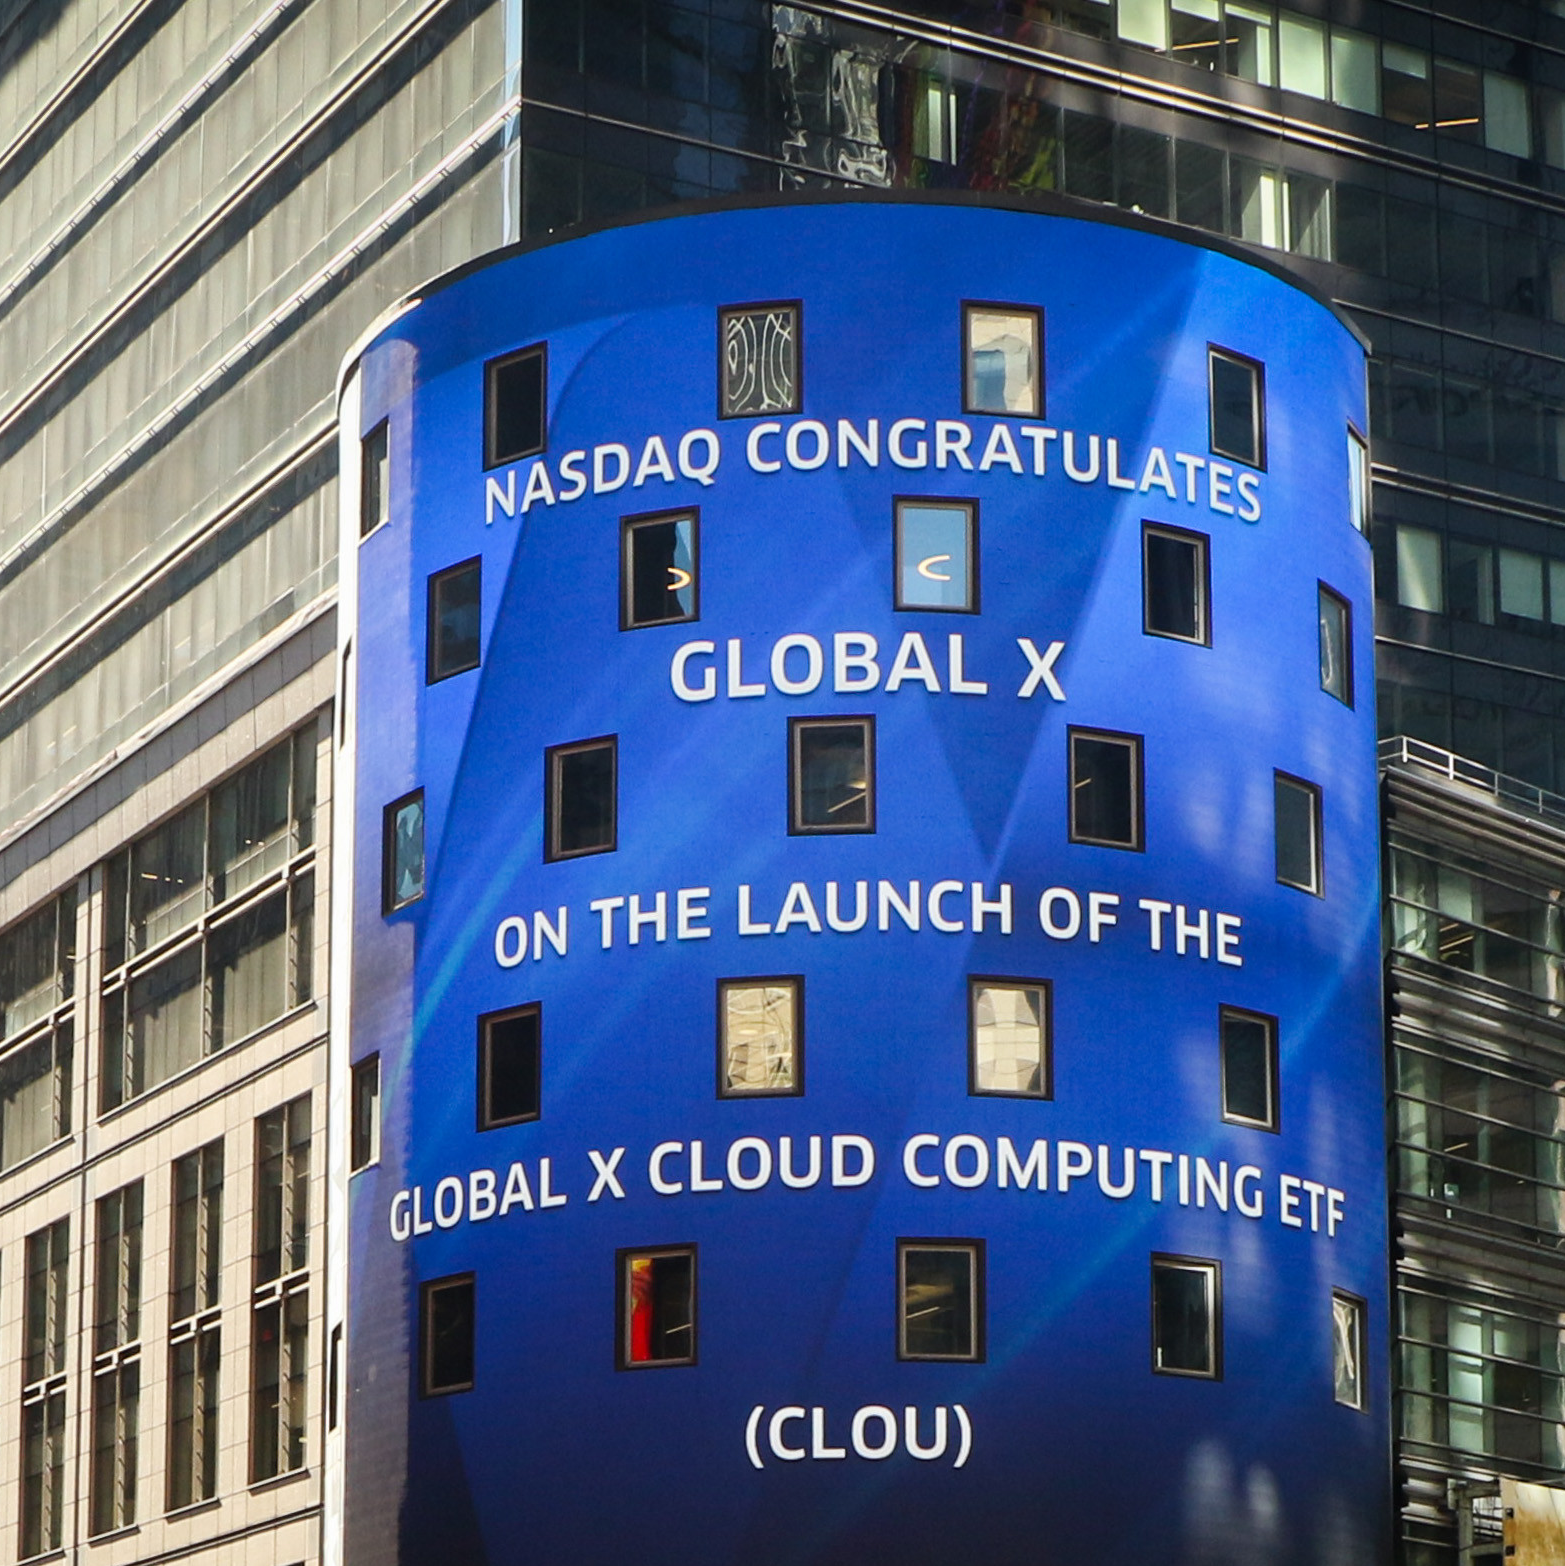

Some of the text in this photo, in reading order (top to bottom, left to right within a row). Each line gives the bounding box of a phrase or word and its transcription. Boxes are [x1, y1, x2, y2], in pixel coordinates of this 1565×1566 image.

[484, 417, 1262, 526] NASDAQ CONGRATULATES
[670, 630, 1068, 704] GLOBAL X
[494, 879, 1245, 969] ON THE LAUNCH OF THE
[389, 1133, 1346, 1243] GLOBAL X CLOUD COMPUTING ETF
[744, 1402, 975, 1471] (CLOU)
